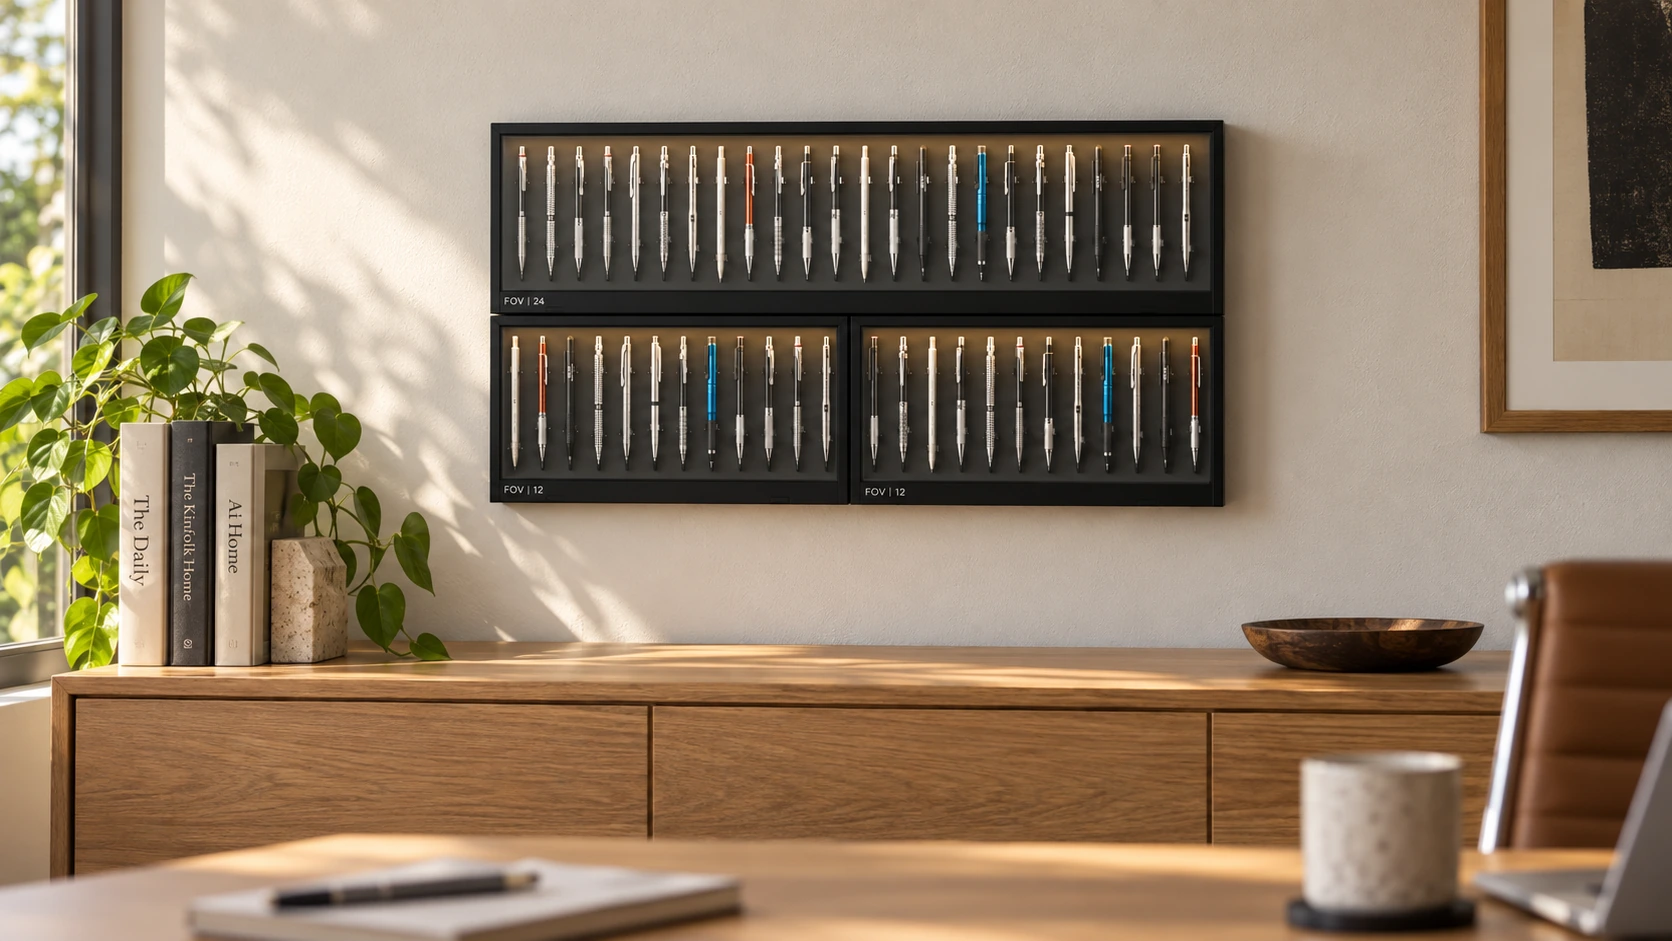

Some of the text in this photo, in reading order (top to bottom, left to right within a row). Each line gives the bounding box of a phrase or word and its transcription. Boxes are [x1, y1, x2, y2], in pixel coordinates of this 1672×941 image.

[504, 297, 525, 305] FOV
[533, 297, 545, 305] 24
[504, 485, 525, 494] FOV
[533, 485, 544, 494] 12
[865, 487, 886, 496] FOV
[895, 487, 906, 496] 12
[129, 495, 149, 586] The Daily
[184, 473, 196, 601] The Kinfolk Home
[228, 499, 242, 574] Ai Home
